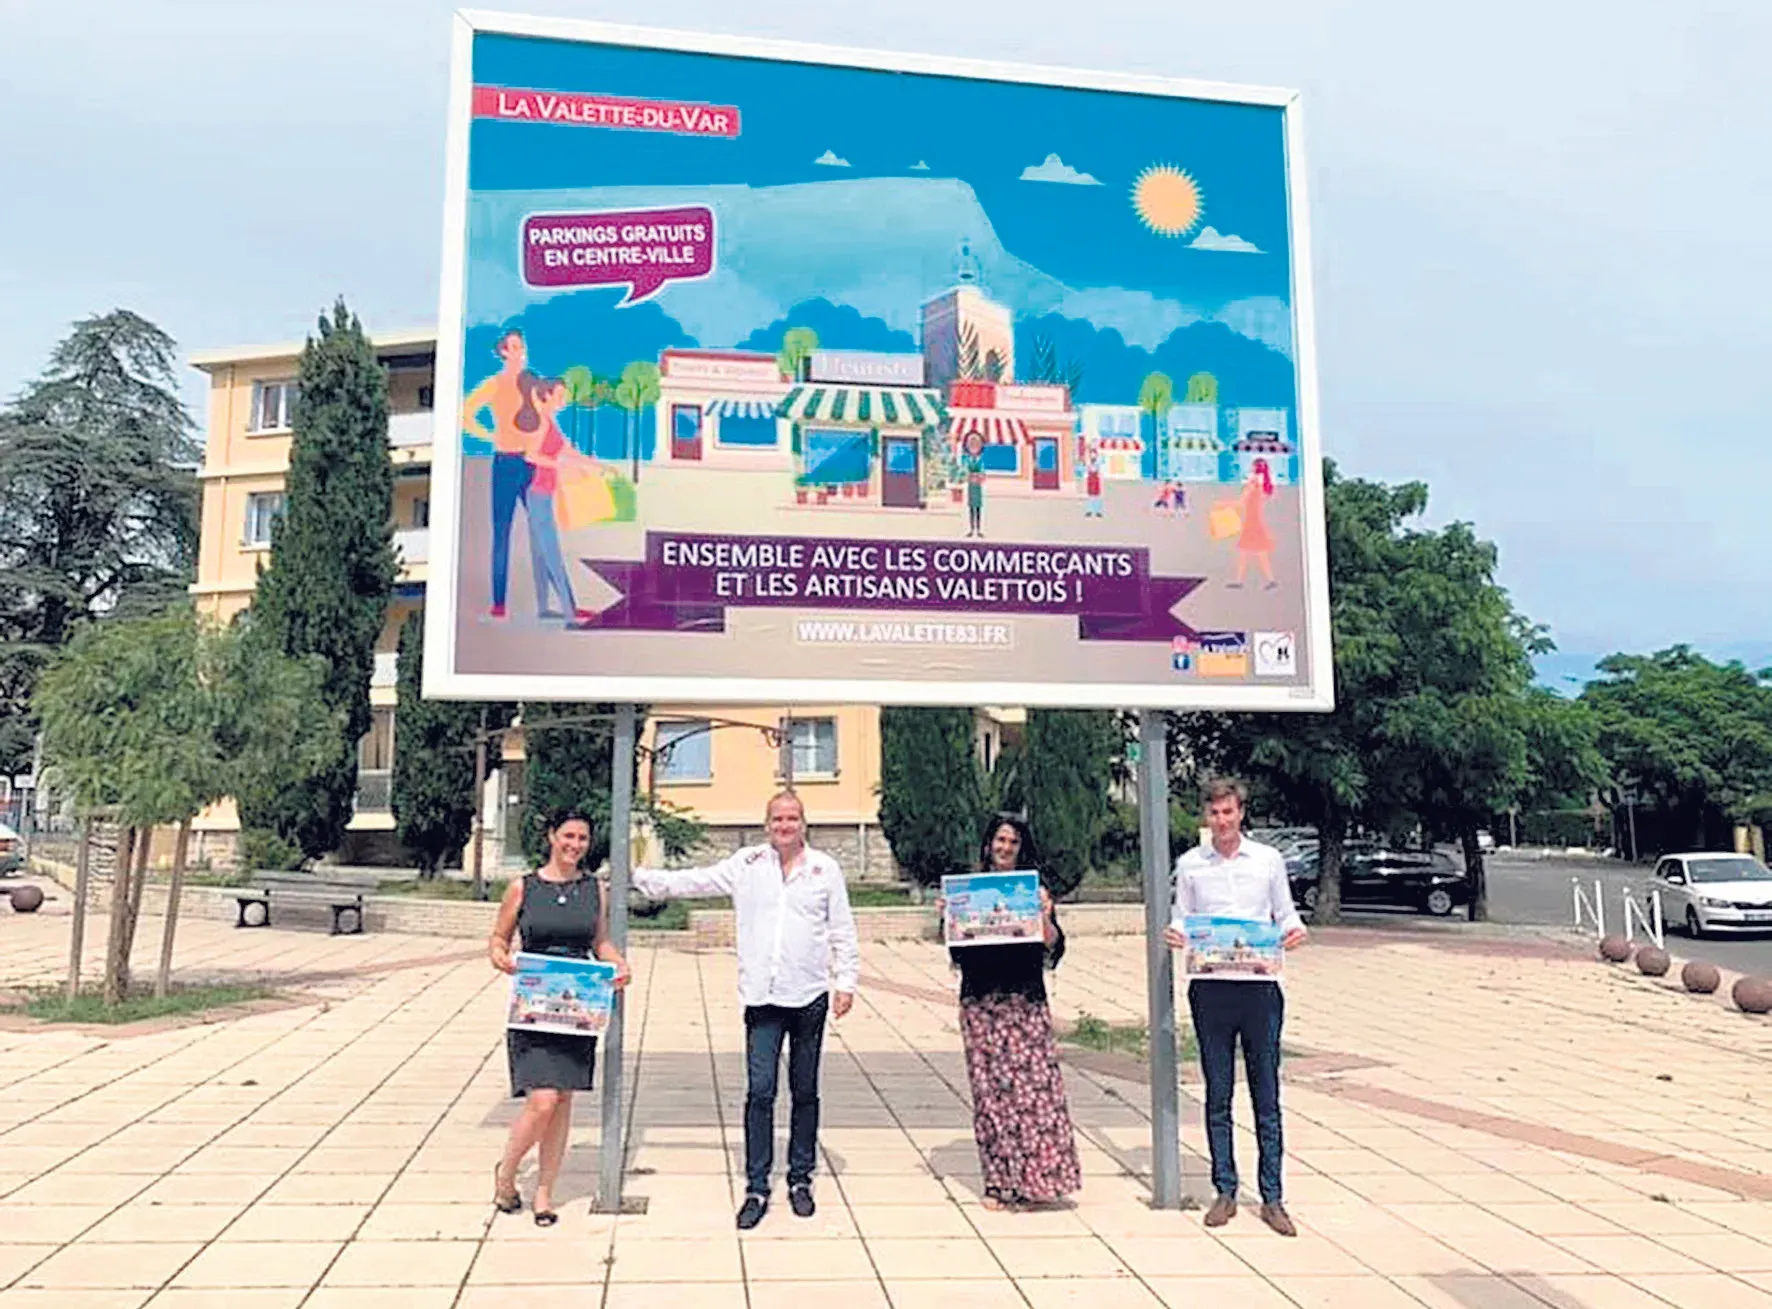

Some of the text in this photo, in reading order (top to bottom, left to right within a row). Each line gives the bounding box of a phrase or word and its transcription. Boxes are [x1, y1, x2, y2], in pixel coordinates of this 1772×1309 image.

[499, 93, 531, 116] LA
[528, 223, 706, 245] PARKINGS GRATUITS
[544, 245, 695, 266] EN CENTRE-VILLE
[662, 541, 1133, 579] ENSEMBLE AVEC LES COMMERÇANTS
[716, 572, 749, 597] ET
[756, 573, 798, 596] LES
[804, 574, 930, 600] ARTISANS
[935, 577, 1067, 603] VALETTOIS
